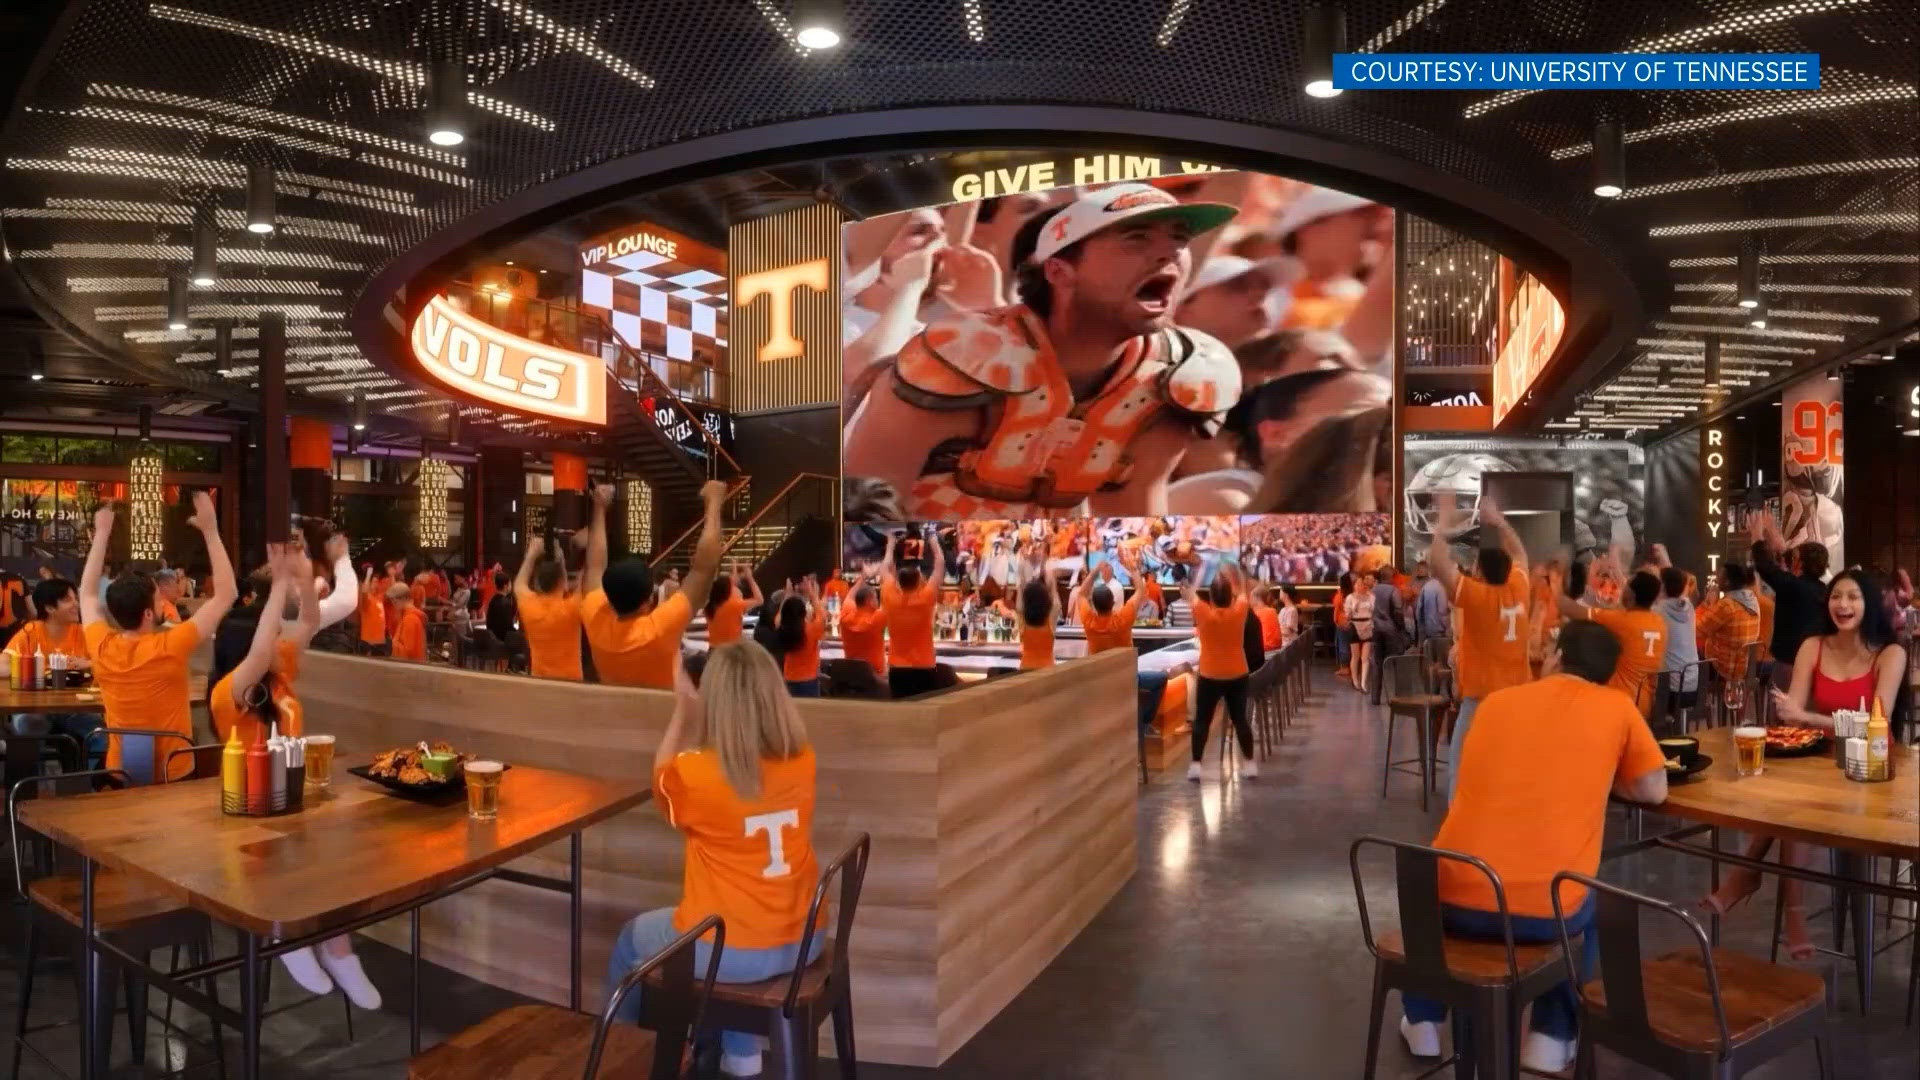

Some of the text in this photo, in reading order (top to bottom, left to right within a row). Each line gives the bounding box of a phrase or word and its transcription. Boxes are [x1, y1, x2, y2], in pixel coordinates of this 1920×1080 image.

[952, 154, 1161, 202] GIVE HIM
[582, 232, 678, 266] VIP LOUNGE
[736, 257, 830, 362] T
[423, 303, 568, 401] VOLS
[1707, 430, 1724, 538] ROCKY
[1642, 631, 1661, 657] T
[744, 808, 800, 878] T
